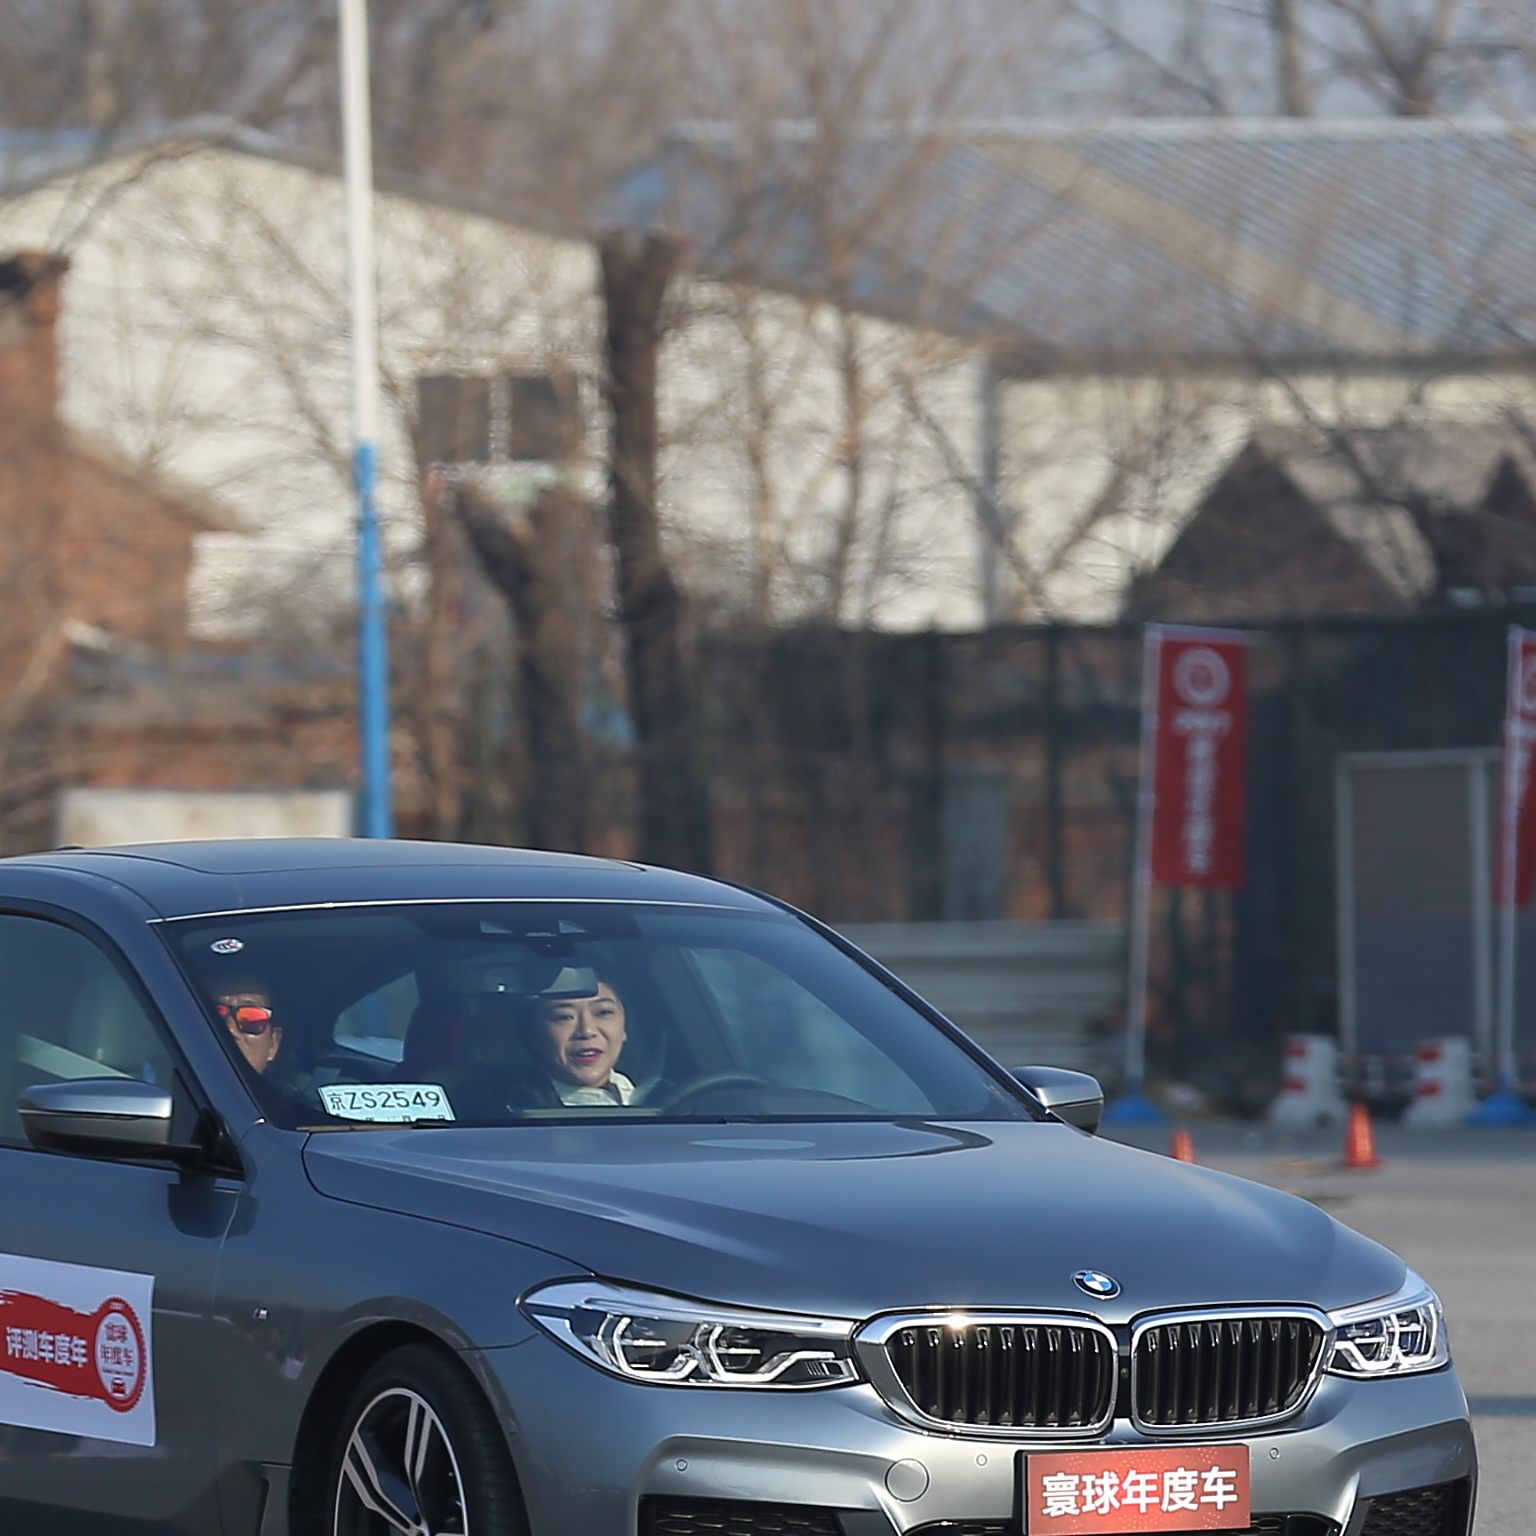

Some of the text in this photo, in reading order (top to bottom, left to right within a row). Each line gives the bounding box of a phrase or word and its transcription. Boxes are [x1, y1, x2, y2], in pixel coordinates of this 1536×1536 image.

[327, 1090, 440, 1111] 京ZS2549
[6, 1326, 88, 1368] 评测车度年
[1042, 1466, 1238, 1517] 寰球年度车
